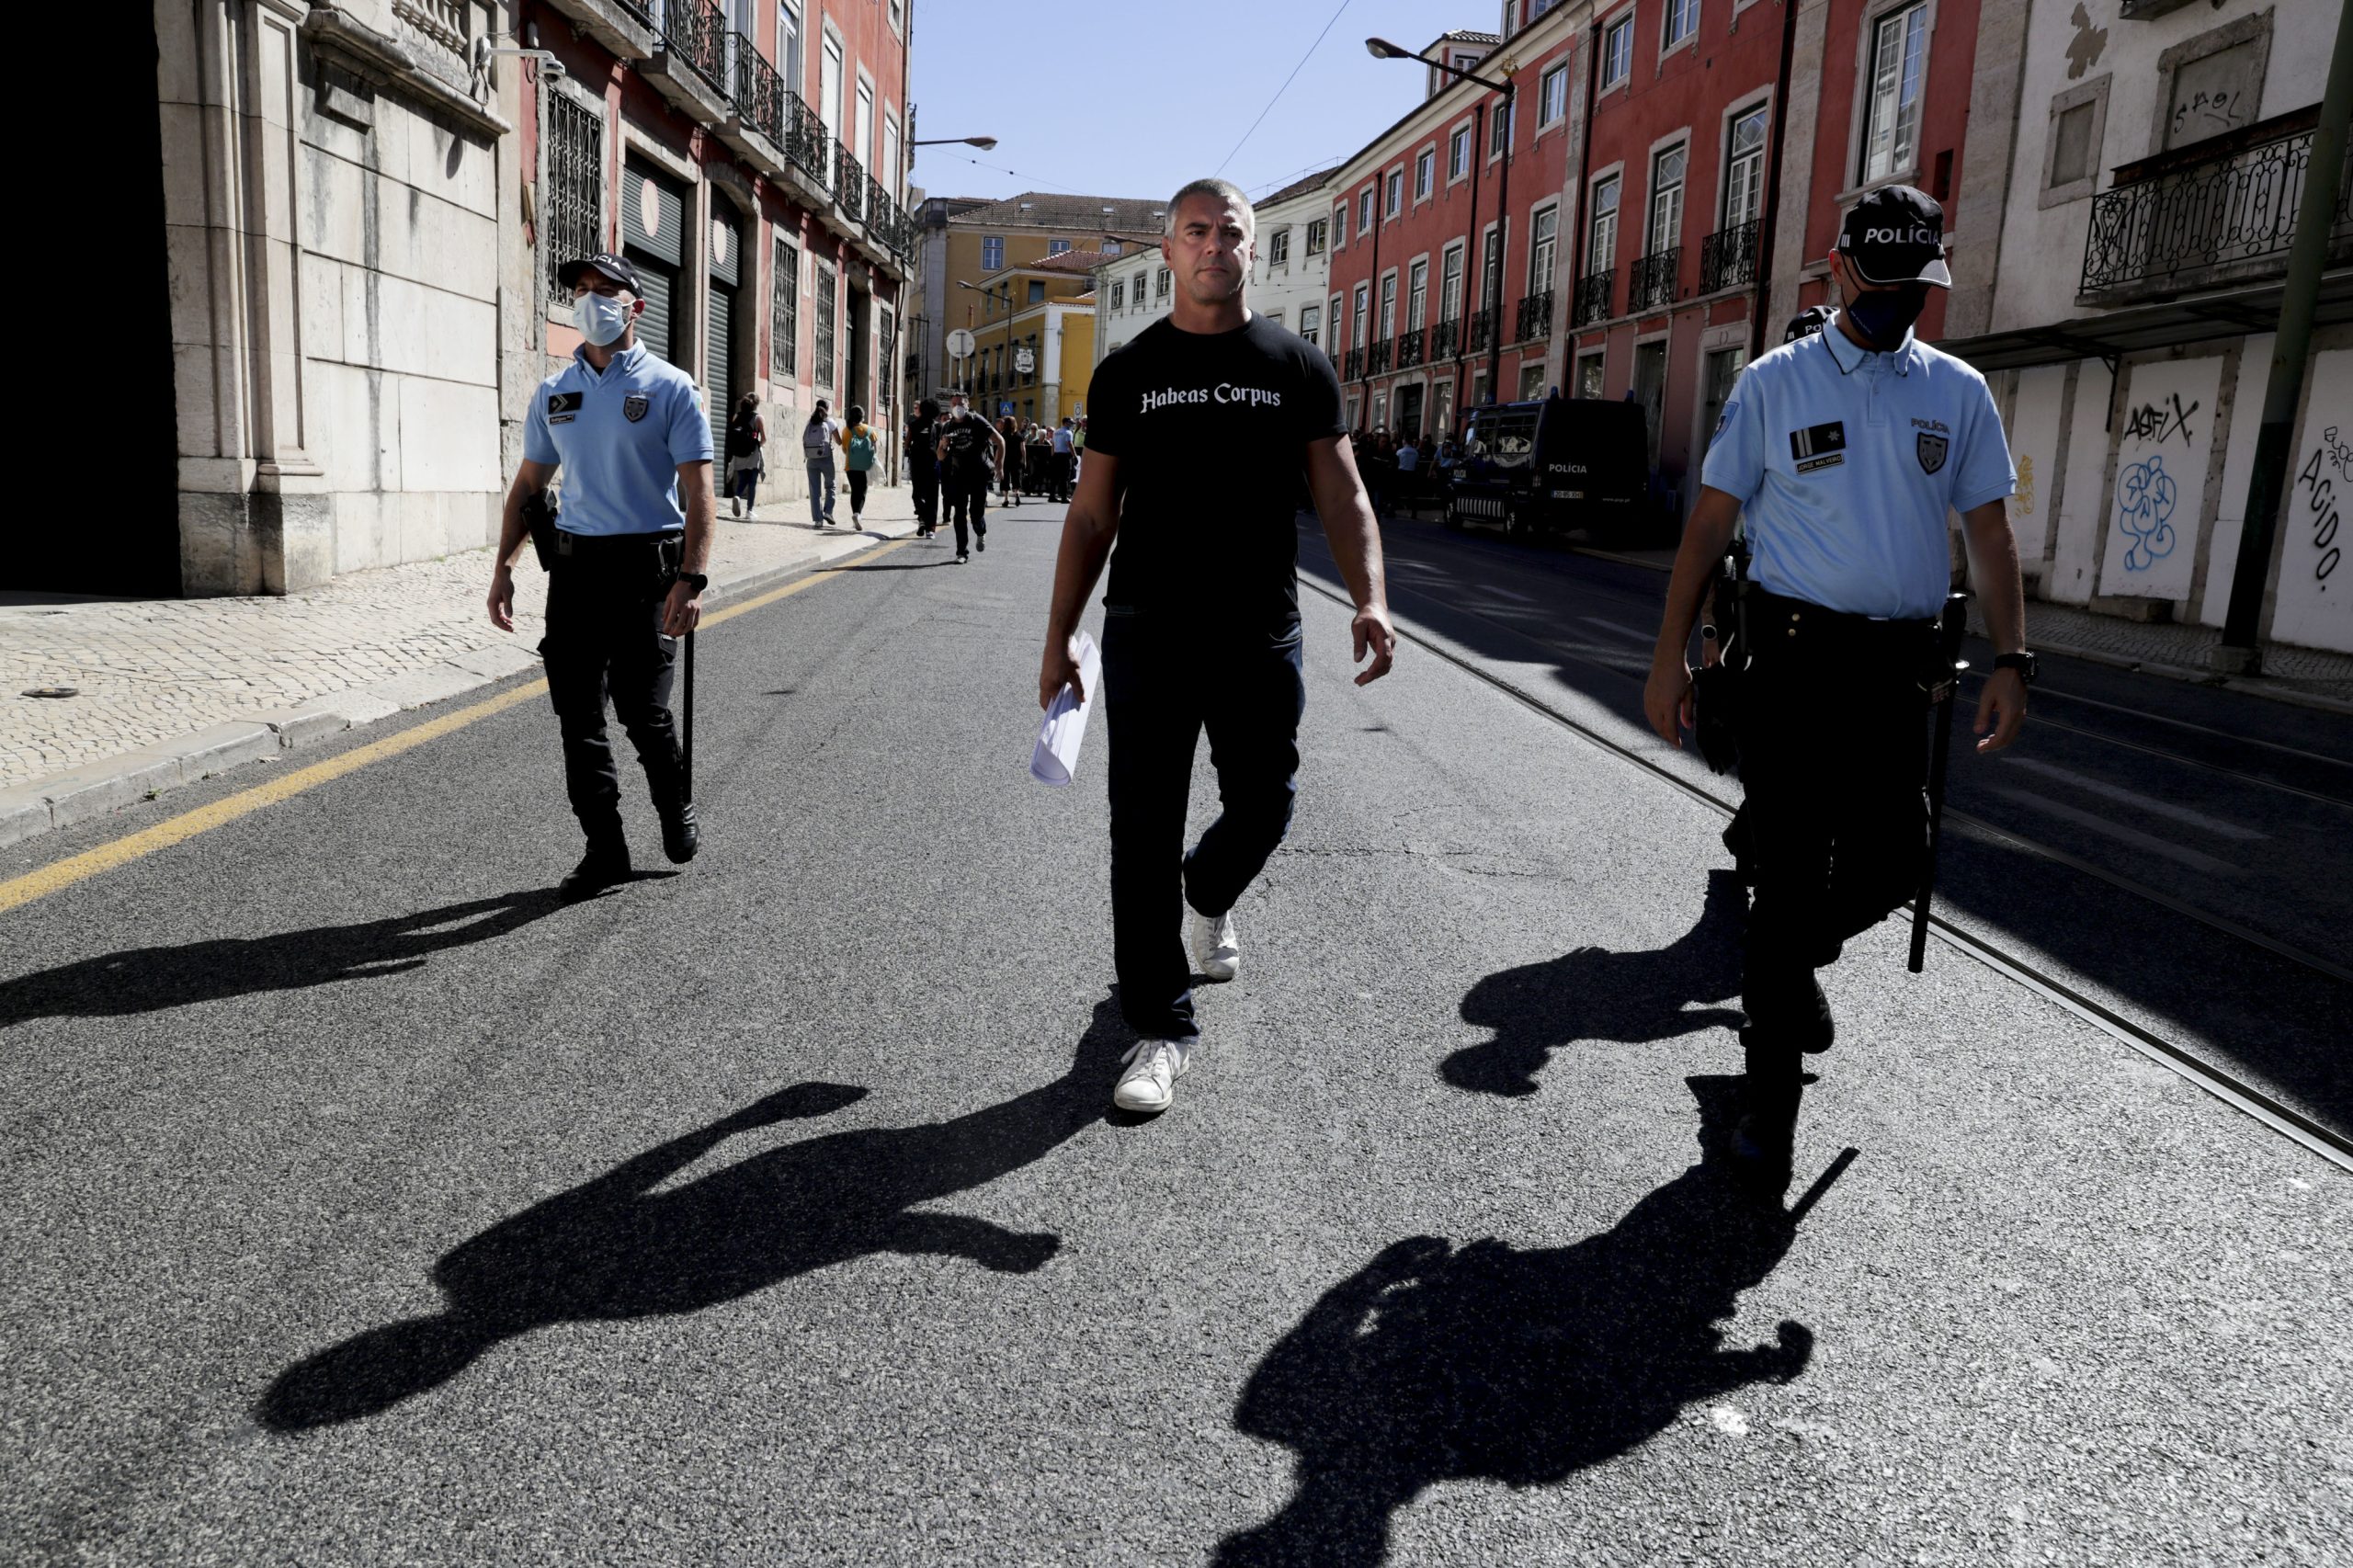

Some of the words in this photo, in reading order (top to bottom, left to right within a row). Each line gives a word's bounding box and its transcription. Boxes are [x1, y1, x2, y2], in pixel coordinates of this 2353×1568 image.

[1864, 224, 1938, 245] POLÍCIA
[1140, 387, 1209, 415] Habeas
[1213, 382, 1281, 407] Corpus
[1911, 417, 1949, 435] POLÍCIA
[1548, 461, 1587, 474] POLÍCIA
